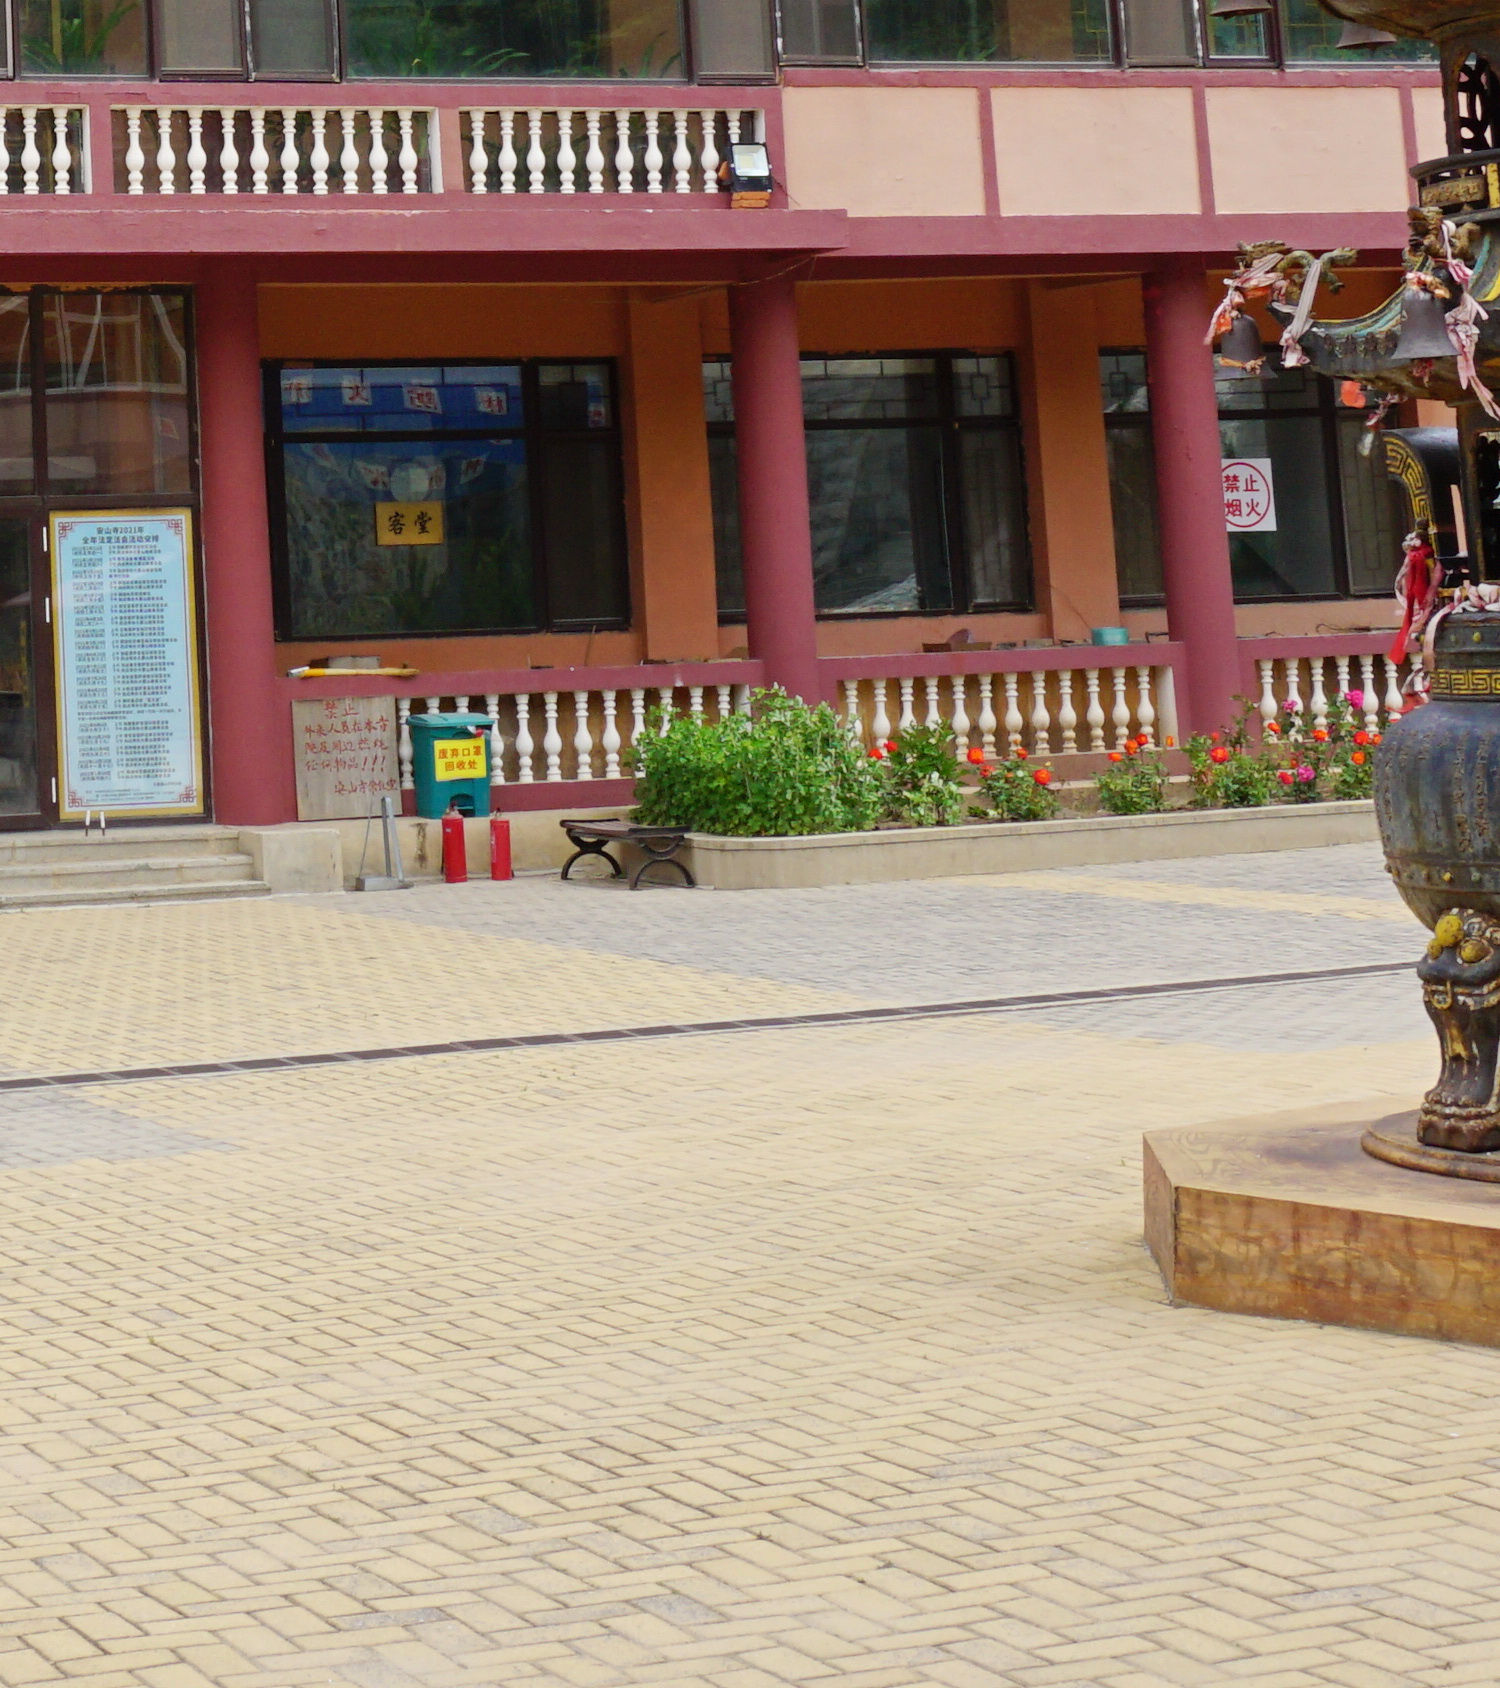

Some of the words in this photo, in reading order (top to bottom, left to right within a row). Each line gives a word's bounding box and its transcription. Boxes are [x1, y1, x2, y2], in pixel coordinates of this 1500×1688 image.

[1223, 474, 1260, 493] 禁止
[1224, 498, 1261, 518] 烟火
[387, 511, 433, 535] 客堂
[325, 700, 359, 719] 禁止
[438, 745, 483, 760] 废弃口罩
[444, 760, 478, 772] 回收处
